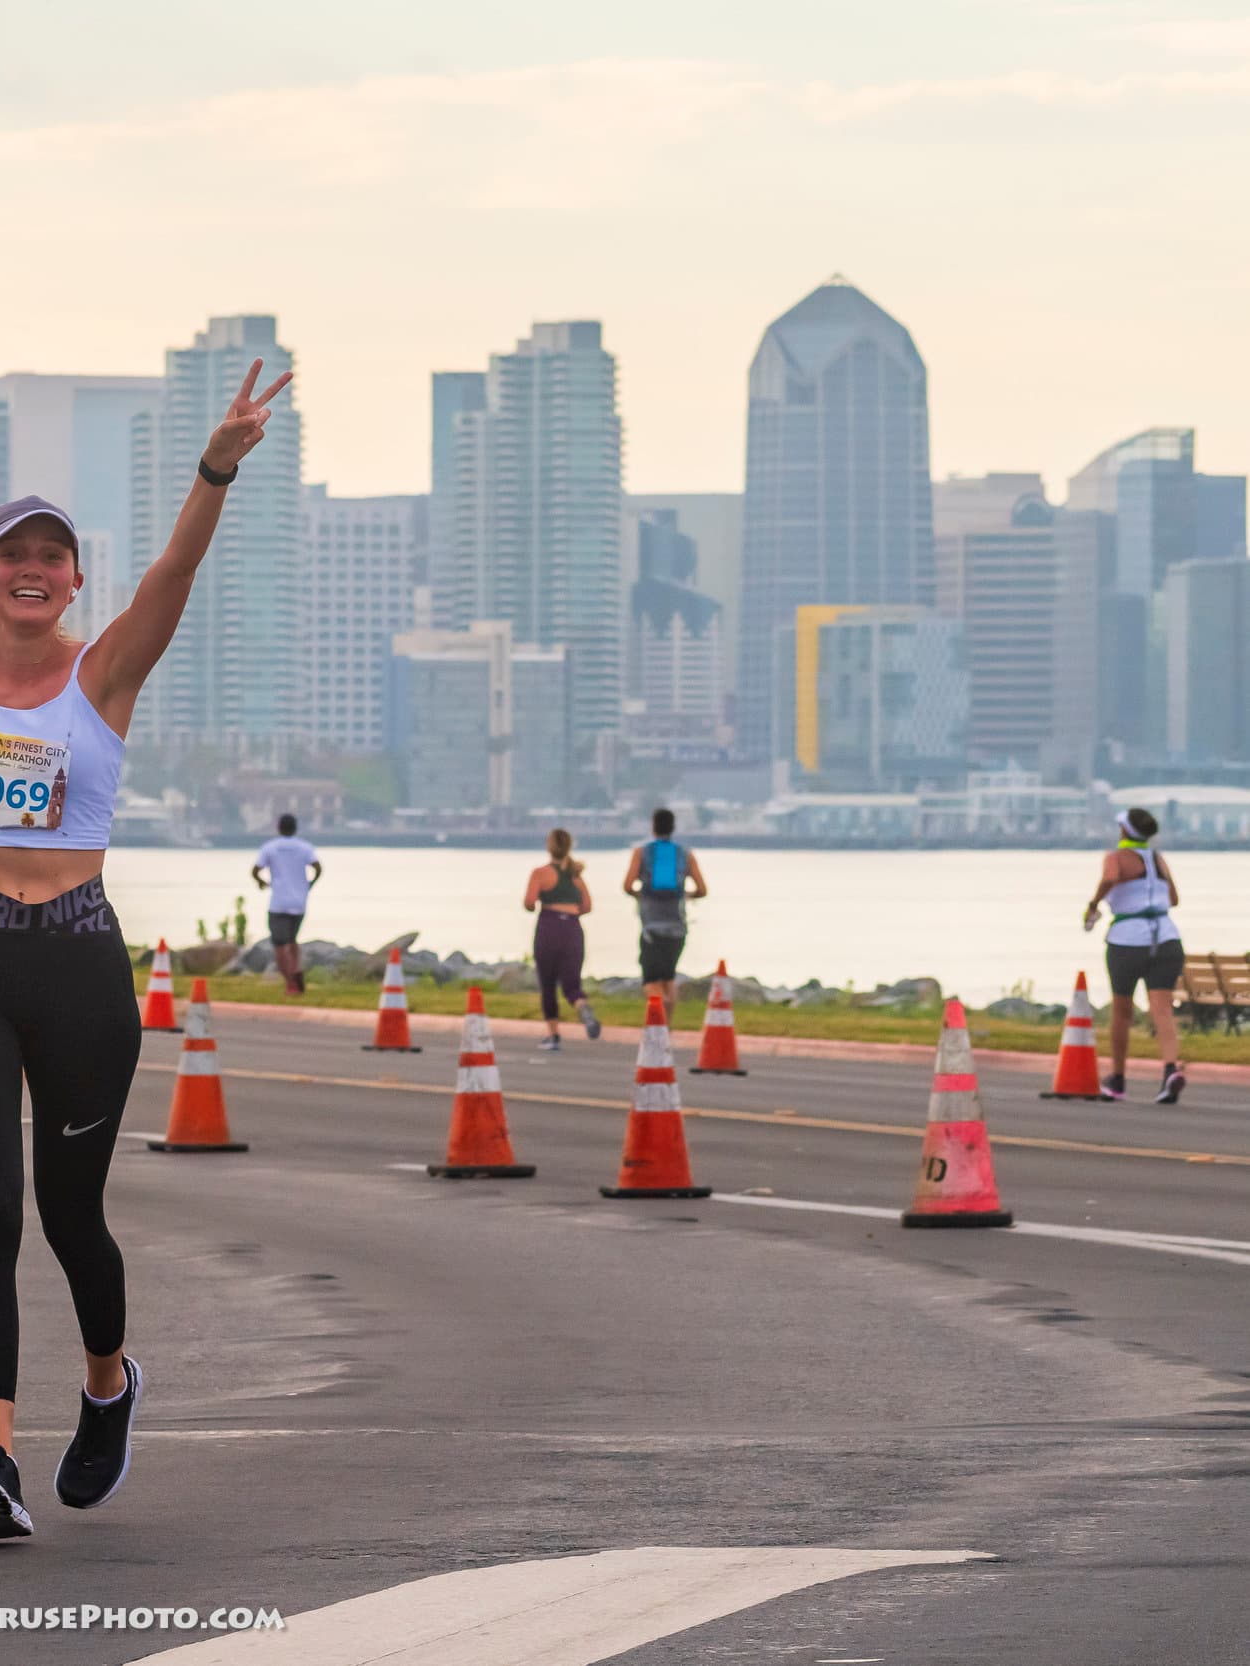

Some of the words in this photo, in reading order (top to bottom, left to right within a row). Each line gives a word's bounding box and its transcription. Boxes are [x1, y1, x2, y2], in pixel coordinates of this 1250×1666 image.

[14, 741, 43, 754] FINEST
[45, 747, 67, 758] CITY
[41, 880, 105, 927] NIKE
[923, 1156, 948, 1182] D
